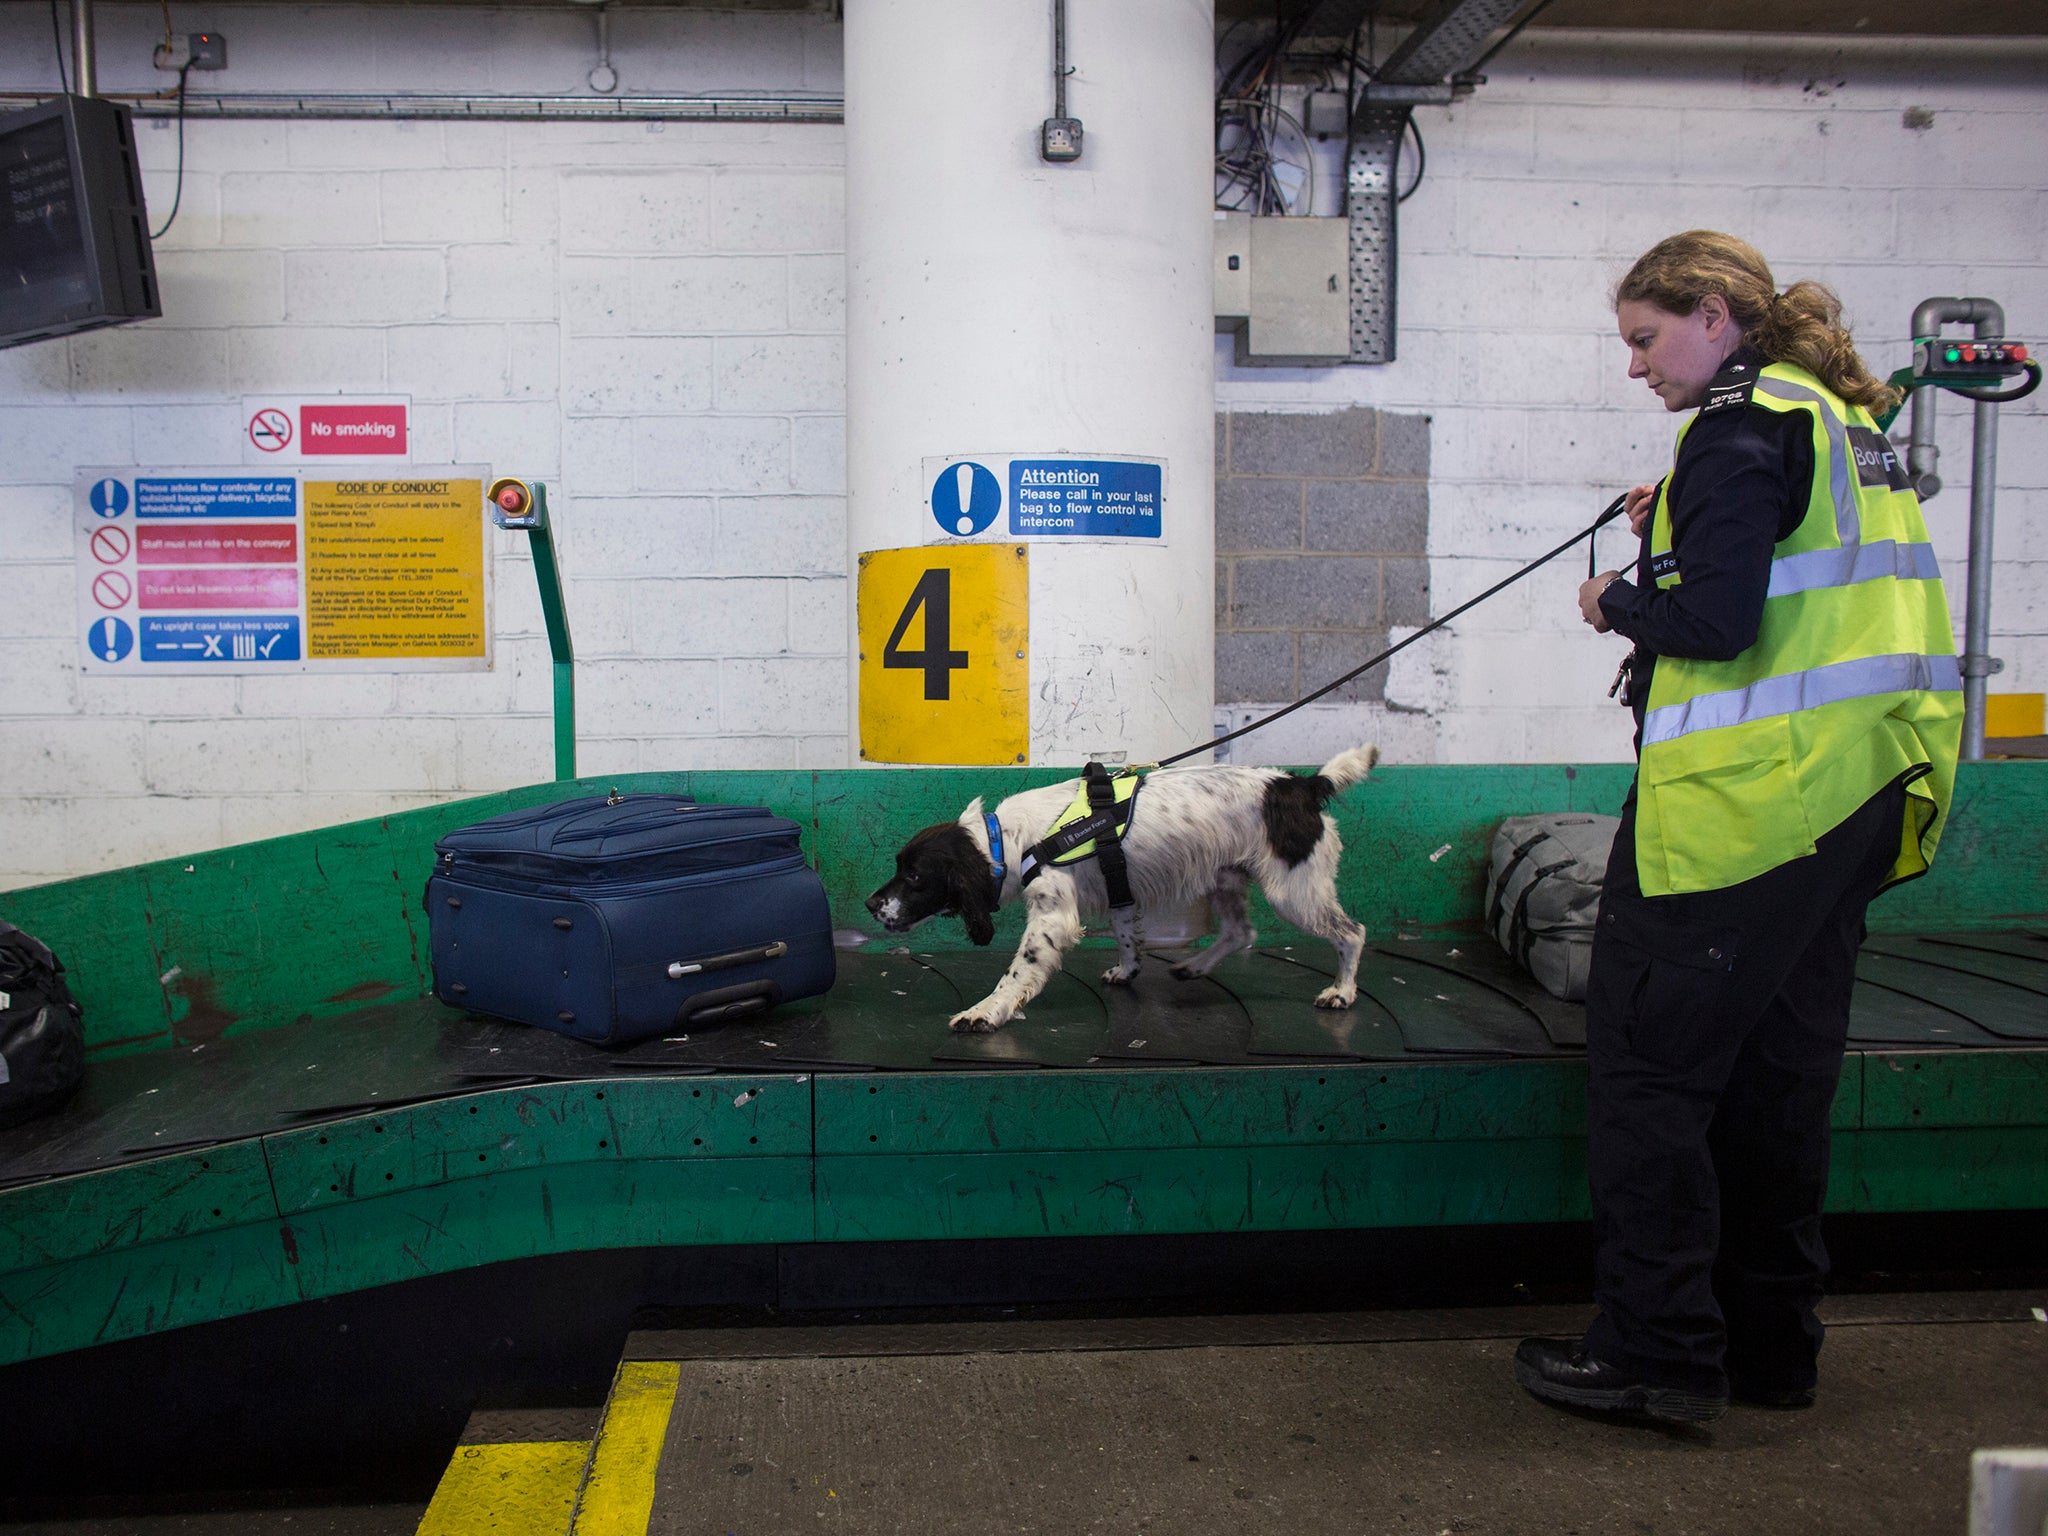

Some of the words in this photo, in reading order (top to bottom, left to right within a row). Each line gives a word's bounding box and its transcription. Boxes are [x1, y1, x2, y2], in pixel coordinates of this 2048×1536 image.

[311, 422, 332, 436] No
[336, 422, 396, 438] smoking
[1853, 446, 1880, 466] Bor
[1881, 451, 1897, 472] F
[1020, 469, 1099, 483] Attention
[139, 483, 168, 492] Please
[171, 483, 198, 492] advise
[200, 483, 219, 492] flow
[221, 483, 261, 492] controller
[264, 482, 274, 492] of
[275, 484, 292, 493] any
[336, 482, 369, 493] CODE
[372, 482, 388, 493] OF
[392, 482, 449, 493] CONDUCT
[139, 494, 176, 503] outsized
[178, 494, 216, 504] baggage
[218, 493, 254, 504] delivery,
[255, 493, 291, 504] bicycles,
[1020, 489, 1061, 500] Please
[1066, 489, 1087, 500] call
[1092, 490, 1102, 500] in
[1107, 492, 1131, 502] your
[1135, 492, 1153, 503] last
[1020, 503, 1043, 515] bag
[1048, 503, 1061, 513] to
[1067, 503, 1092, 514] flow
[1097, 504, 1136, 515] control
[1140, 506, 1153, 516] via
[1020, 517, 1074, 527] intercom
[141, 539, 163, 549] Staff
[164, 539, 186, 549] must
[188, 539, 202, 549] not
[204, 539, 221, 549] ride
[223, 540, 235, 549] on
[236, 539, 251, 548] the
[253, 540, 292, 549] conveyor
[149, 622, 162, 631] An
[164, 622, 194, 633] upright
[195, 623, 217, 631] case
[219, 621, 241, 630] takes
[244, 621, 261, 630] less
[263, 623, 290, 632] space
[883, 568, 969, 701] 4
[1074, 826, 1092, 839] Border
[1091, 818, 1107, 829] Force
